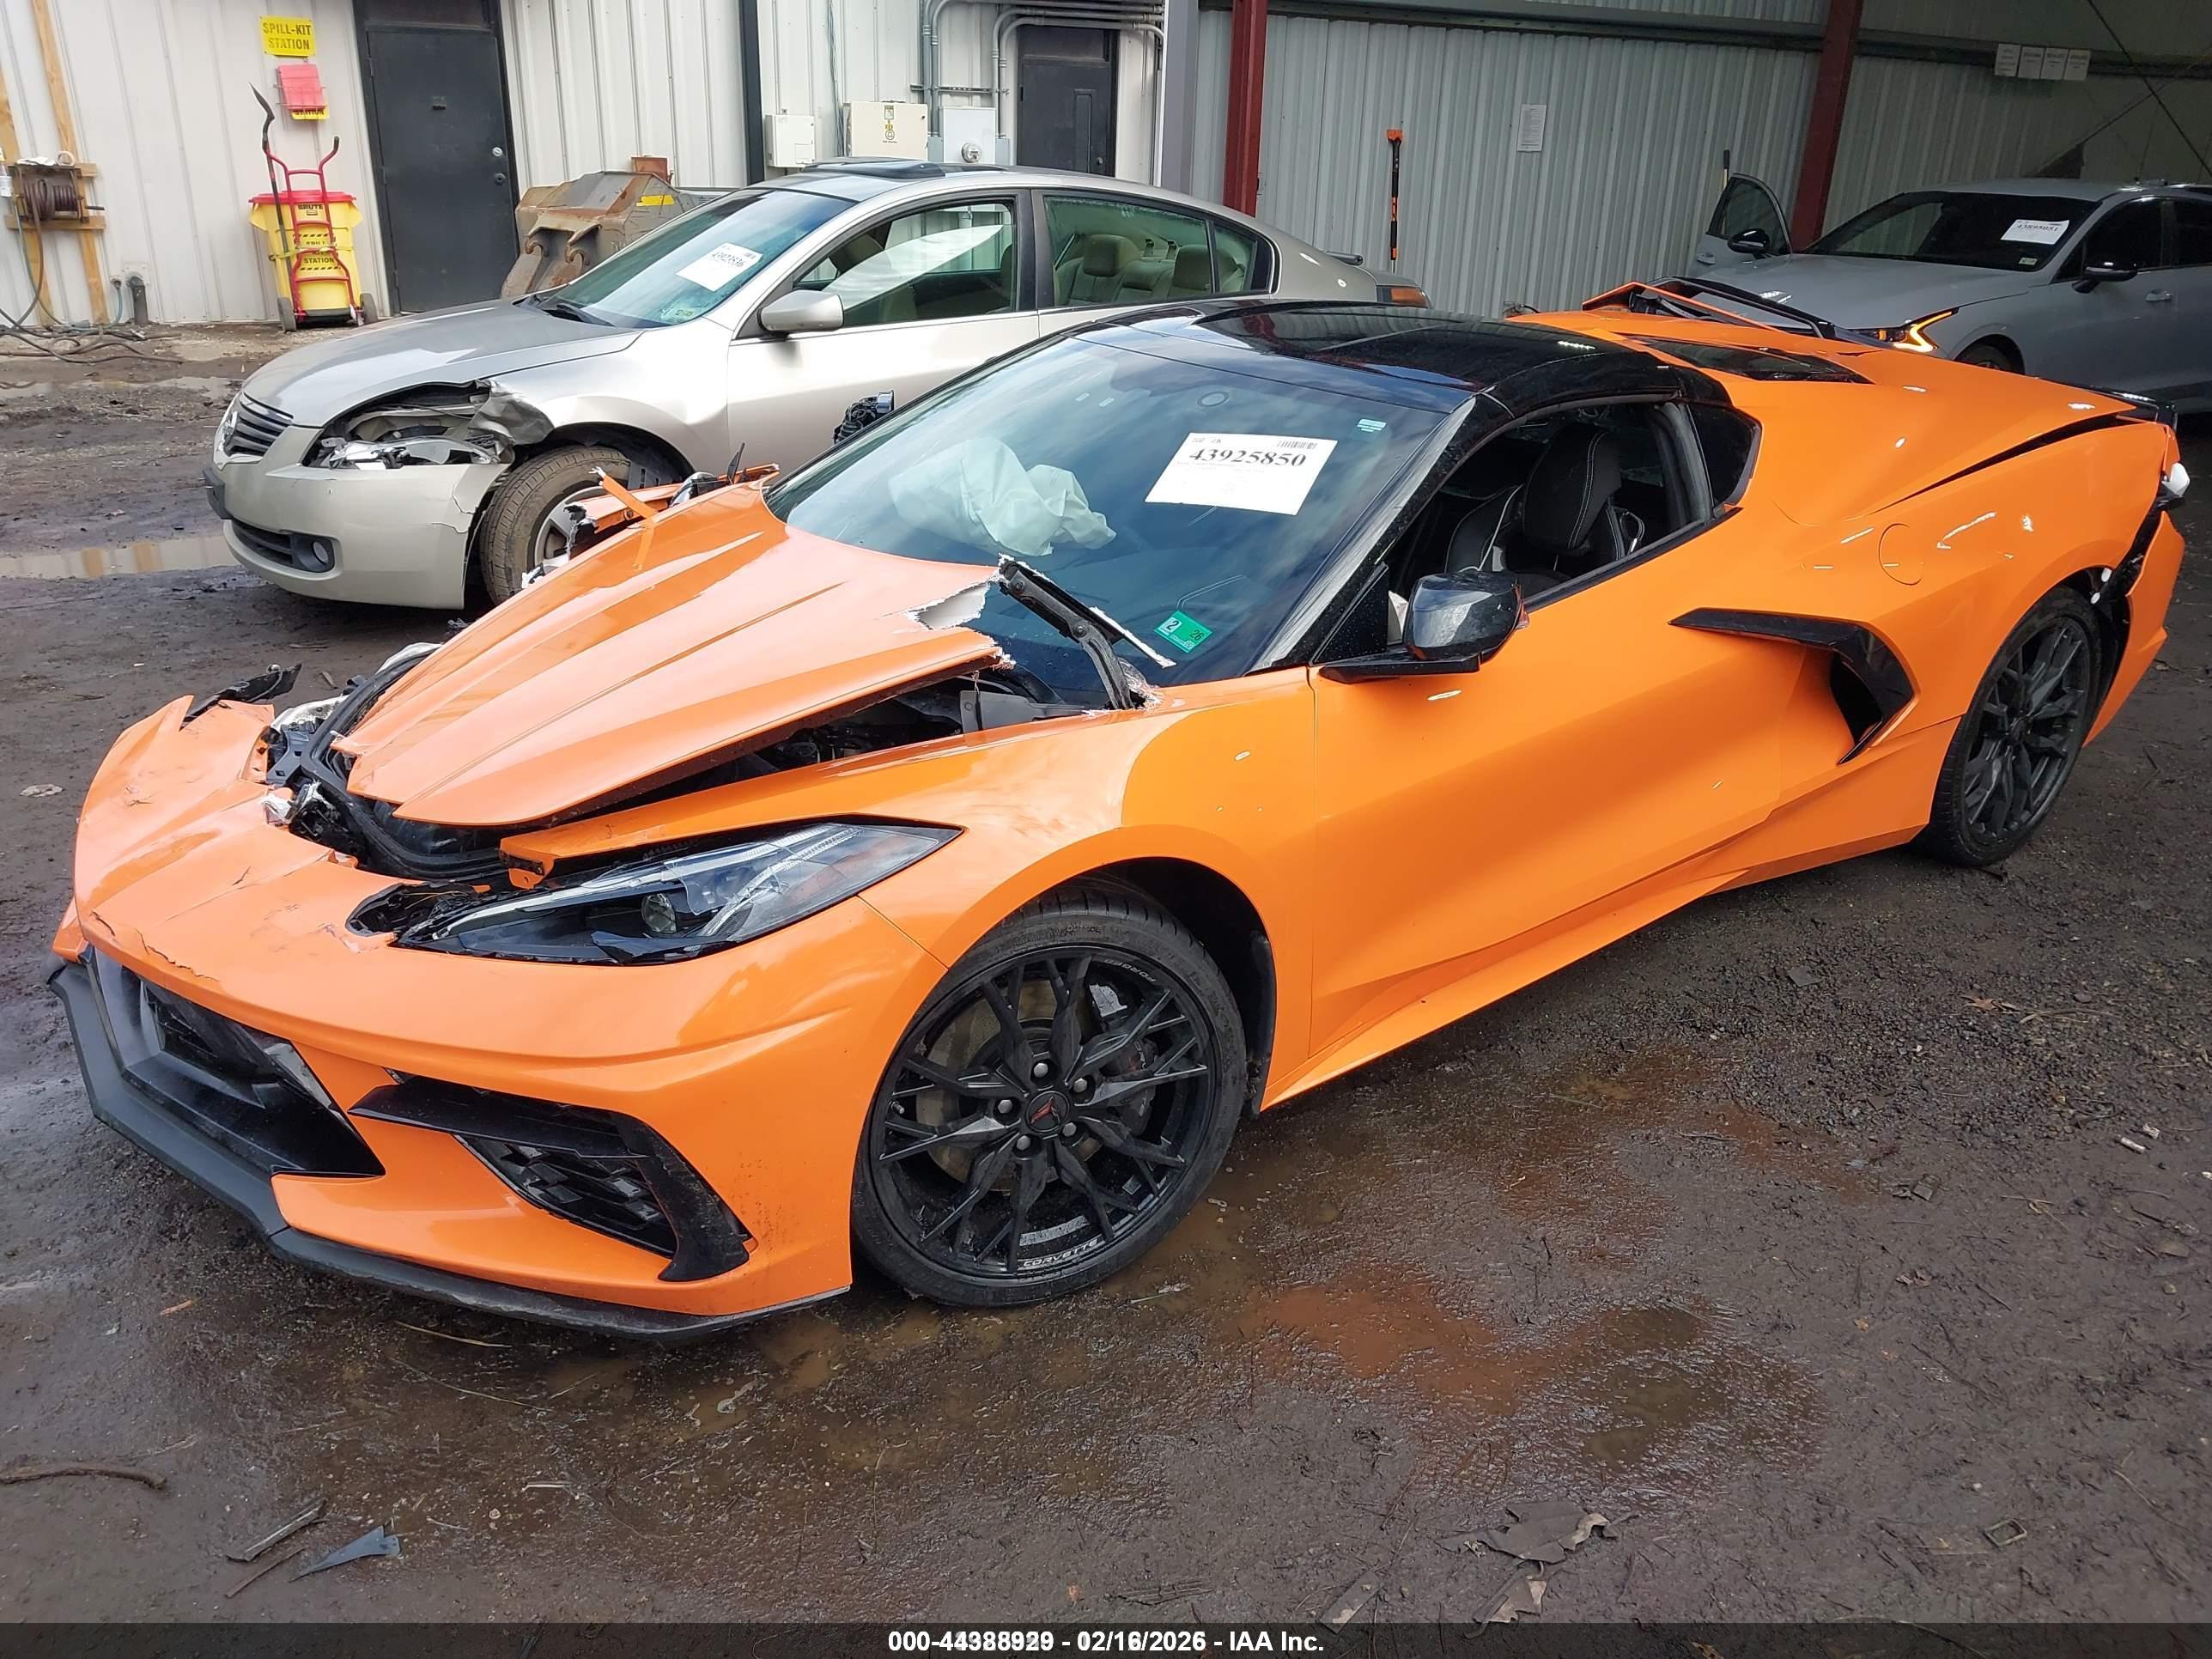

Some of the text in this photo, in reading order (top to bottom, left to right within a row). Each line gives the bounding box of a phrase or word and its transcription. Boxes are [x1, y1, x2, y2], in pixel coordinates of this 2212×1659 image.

[263, 22, 311, 35] SPILL-KIT
[268, 38, 309, 50] STATION
[1189, 448, 1306, 466] 43925850
[1166, 620, 1179, 630] 2
[1189, 629, 1204, 641] 26
[1024, 1238, 1097, 1267] CORVETTE
